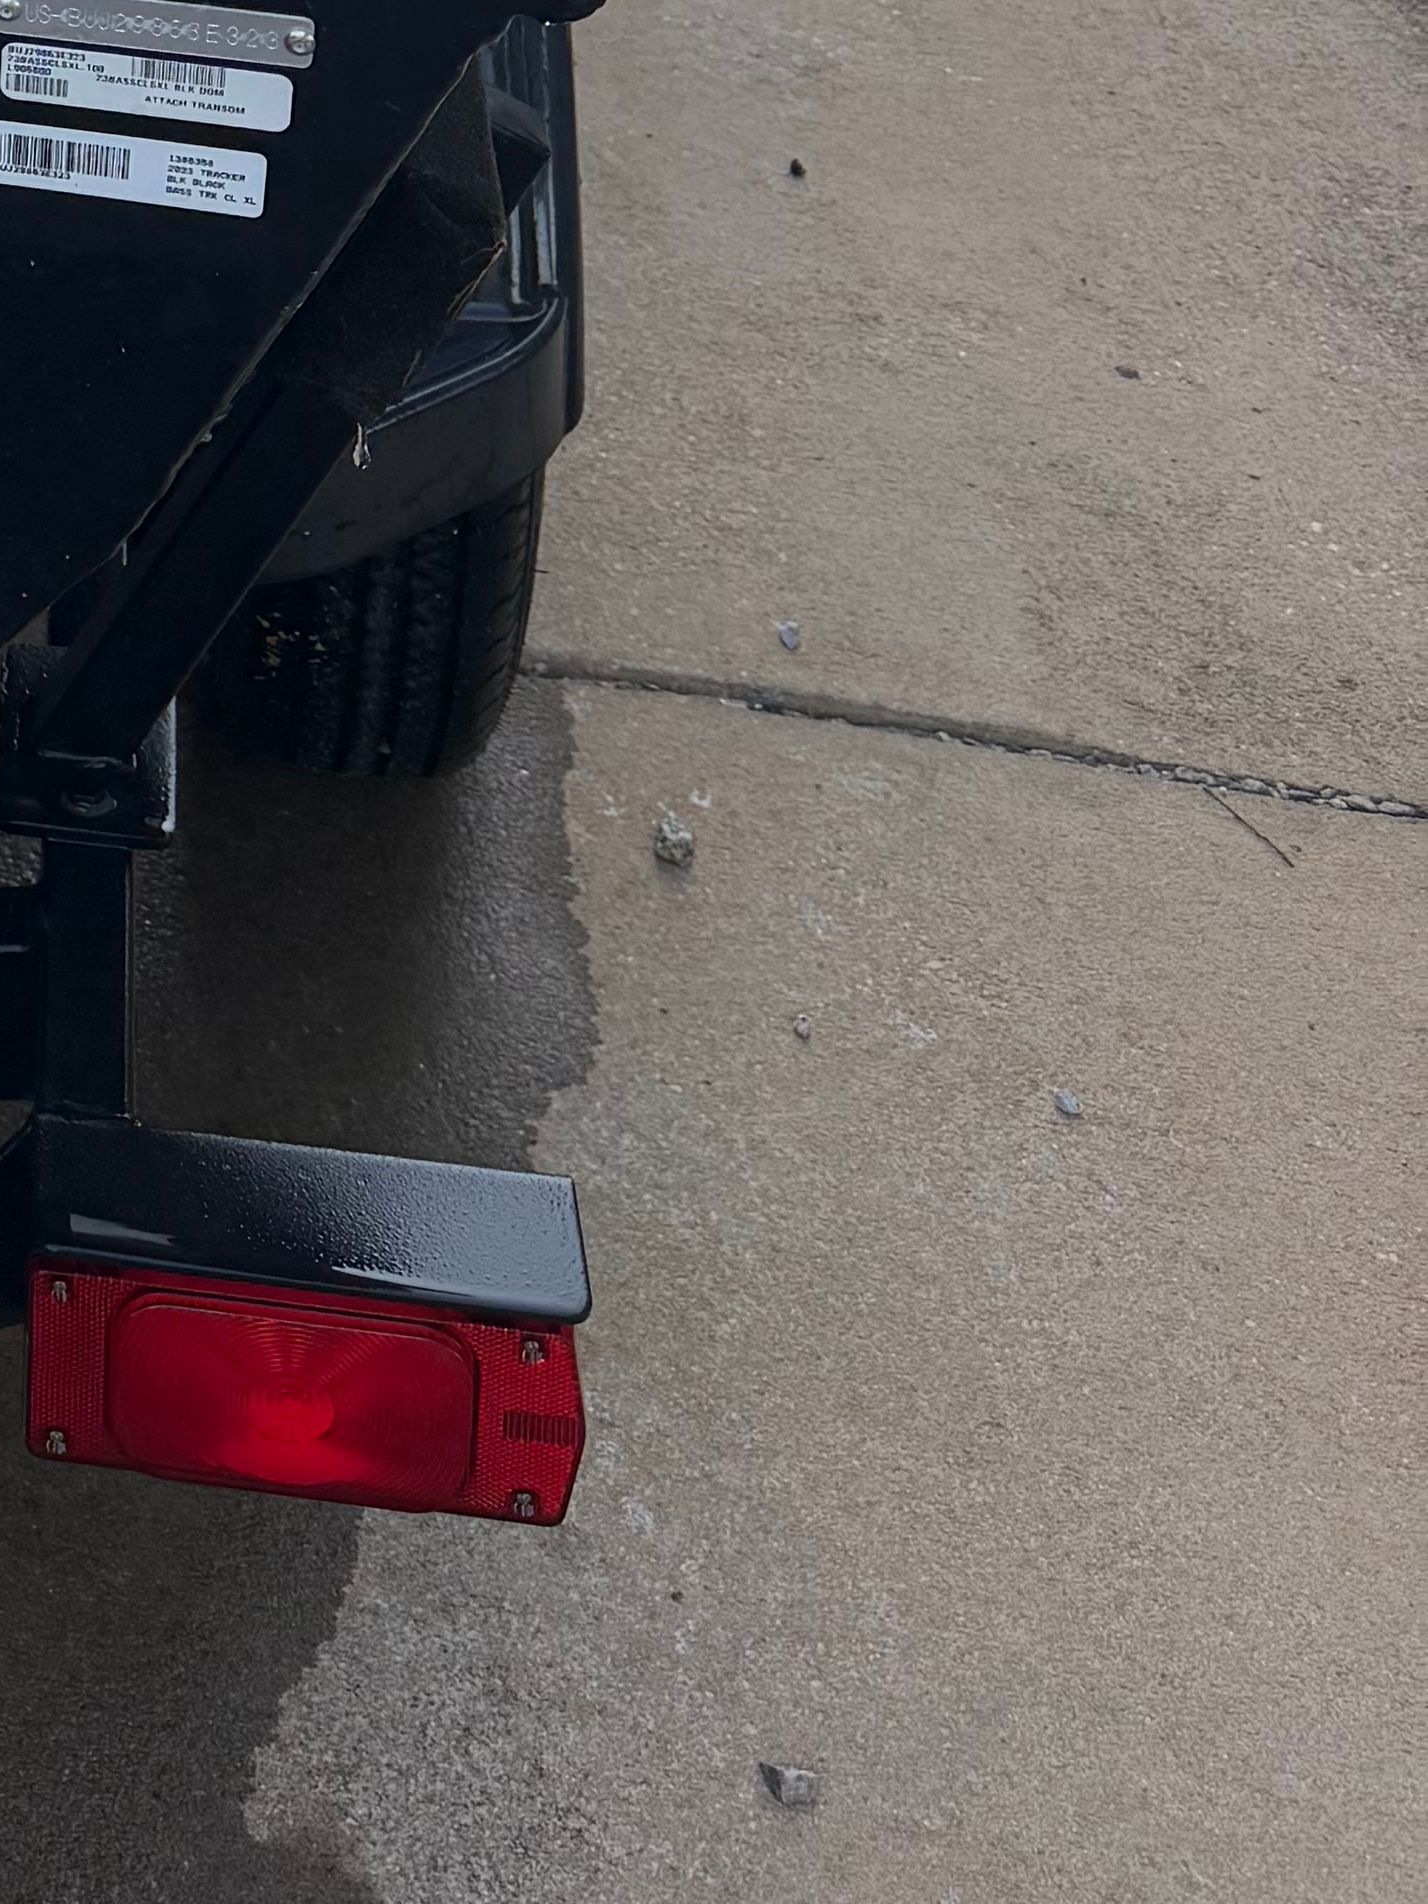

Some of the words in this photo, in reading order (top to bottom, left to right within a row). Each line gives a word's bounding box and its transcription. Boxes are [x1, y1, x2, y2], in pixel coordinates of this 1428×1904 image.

[145, 95, 187, 107] ATTACH
[192, 101, 246, 114] TRANSOM
[200, 168, 246, 182] TRACKER
[192, 178, 226, 190] BLACK
[224, 194, 237, 203] CL
[243, 196, 257, 206] XL
